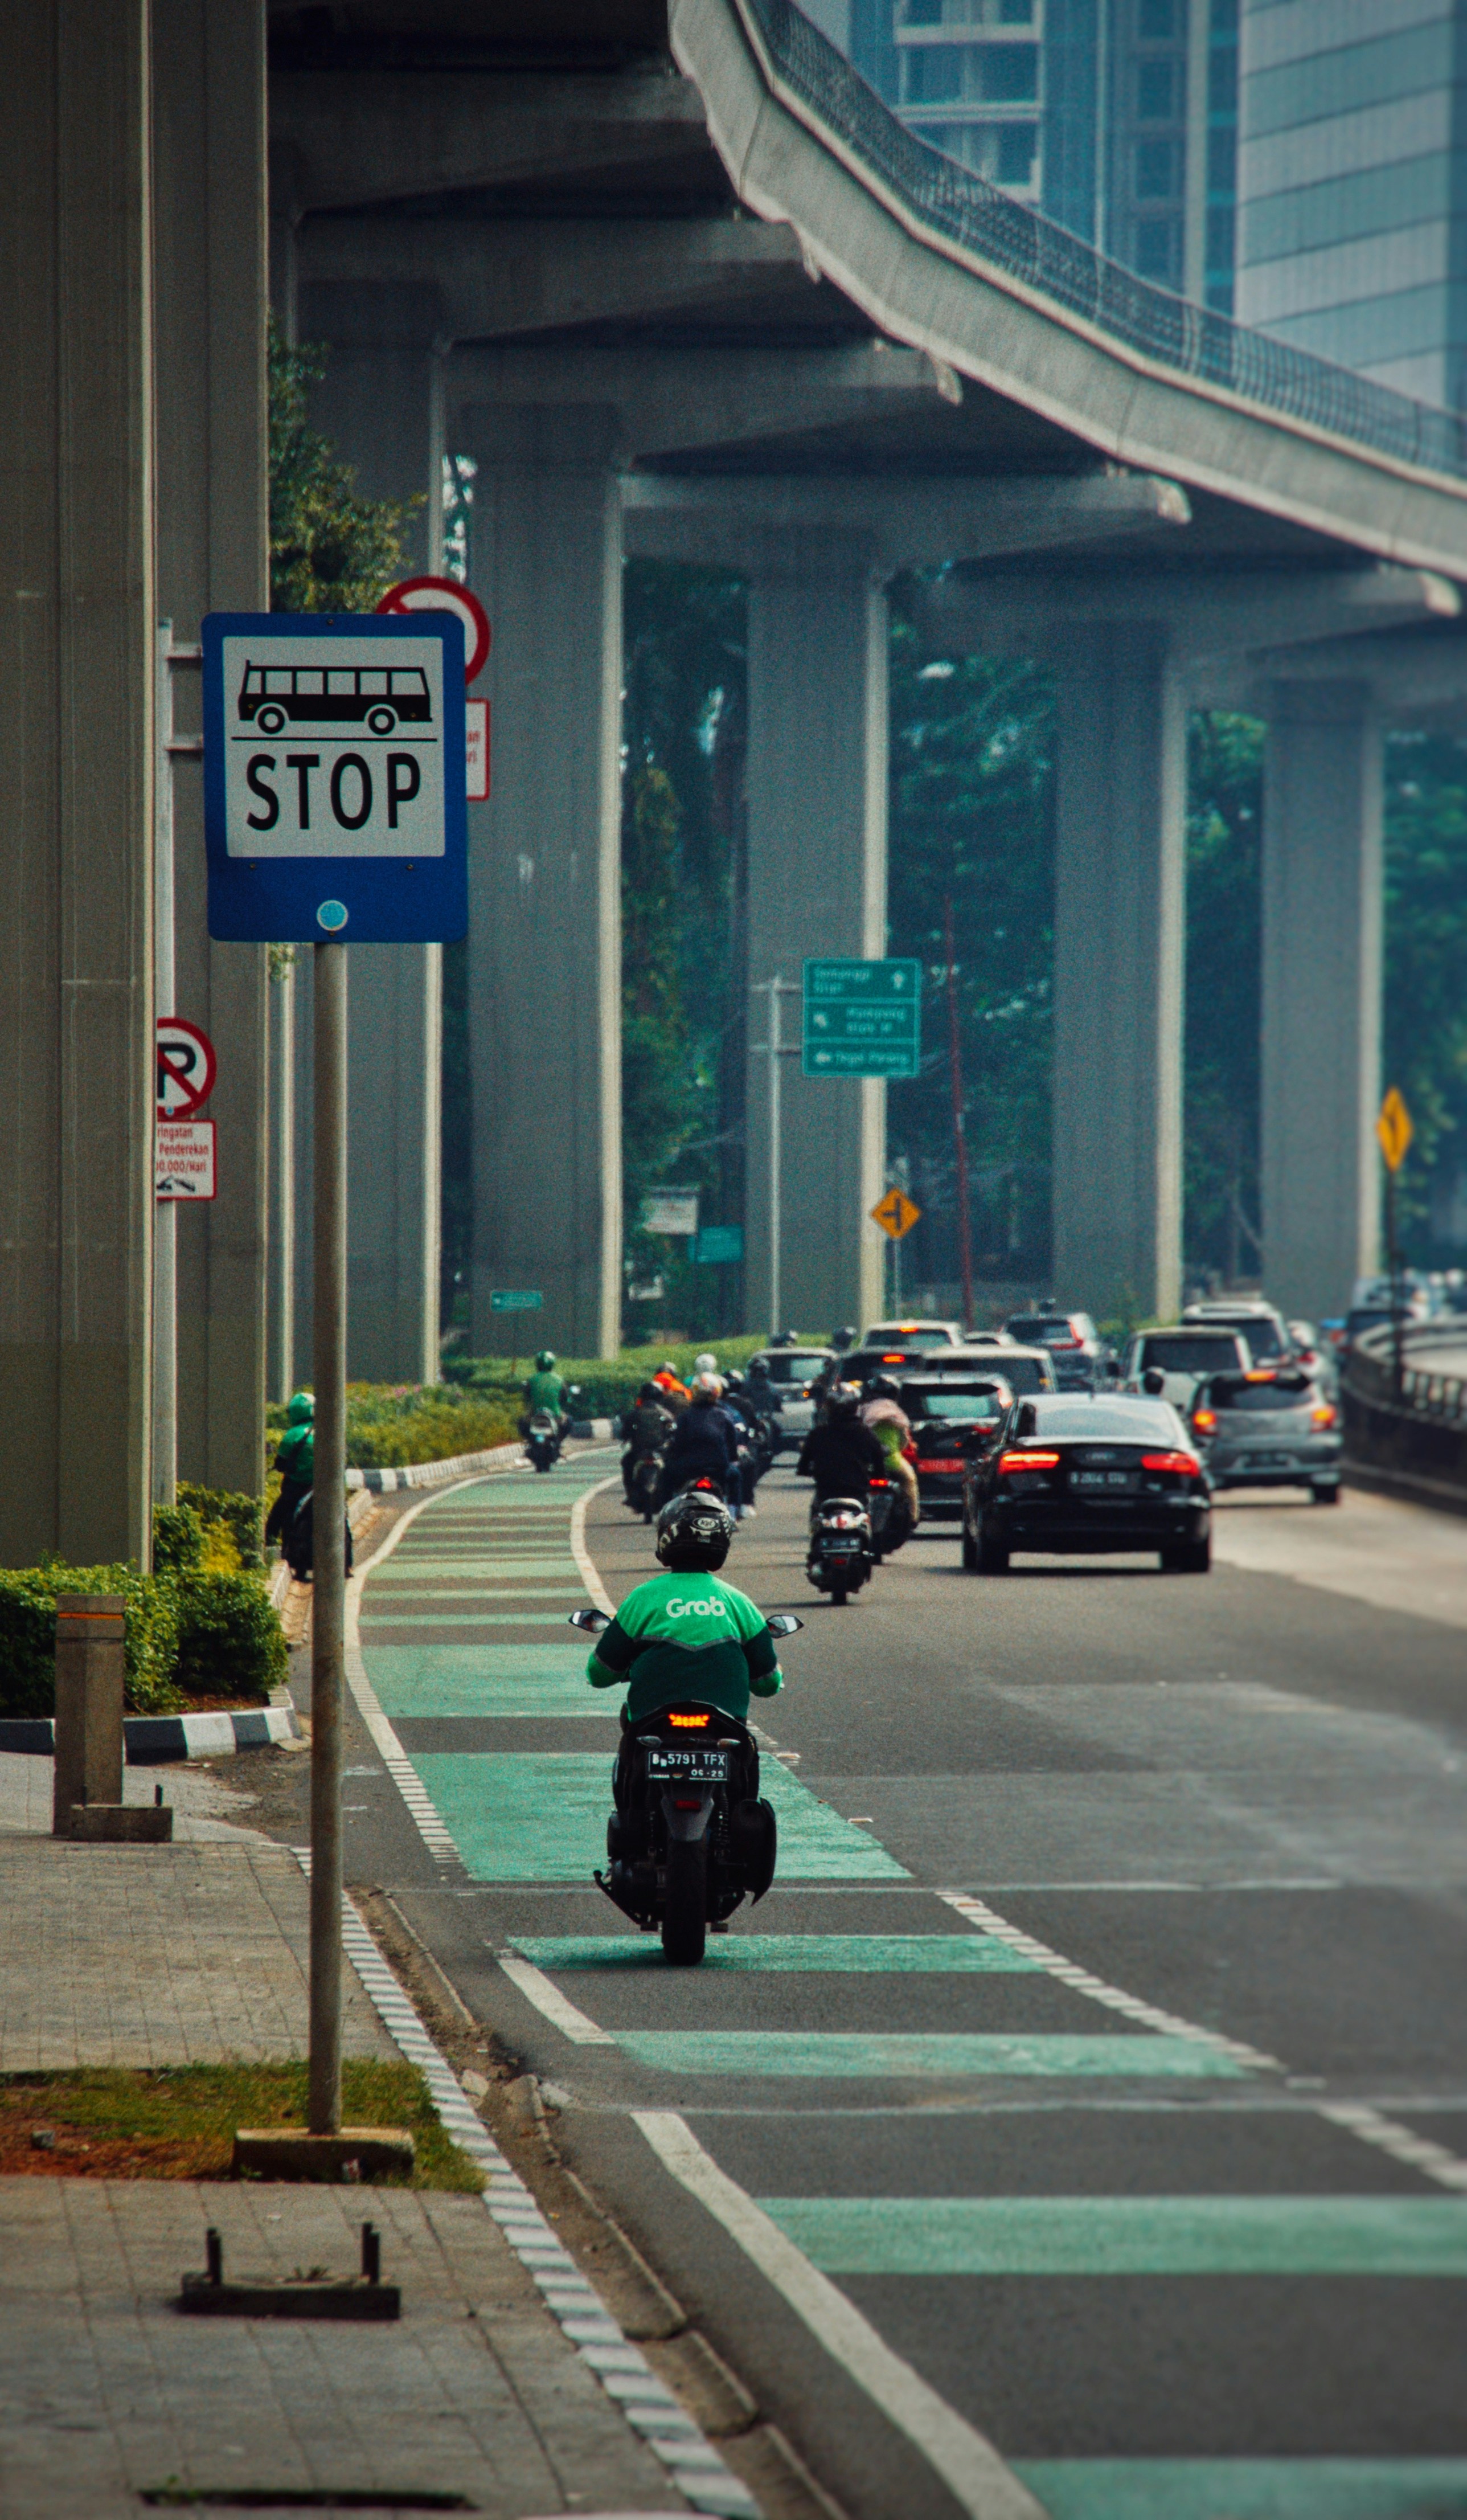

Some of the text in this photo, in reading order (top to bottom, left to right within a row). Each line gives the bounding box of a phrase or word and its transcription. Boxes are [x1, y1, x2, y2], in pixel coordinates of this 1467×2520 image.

[247, 752, 421, 831] STOP
[157, 1127, 193, 1142] ringatan
[159, 1142, 209, 1156] Penderekan
[666, 1596, 726, 1618] Grab
[652, 1753, 725, 1766] B 5791 TFX
